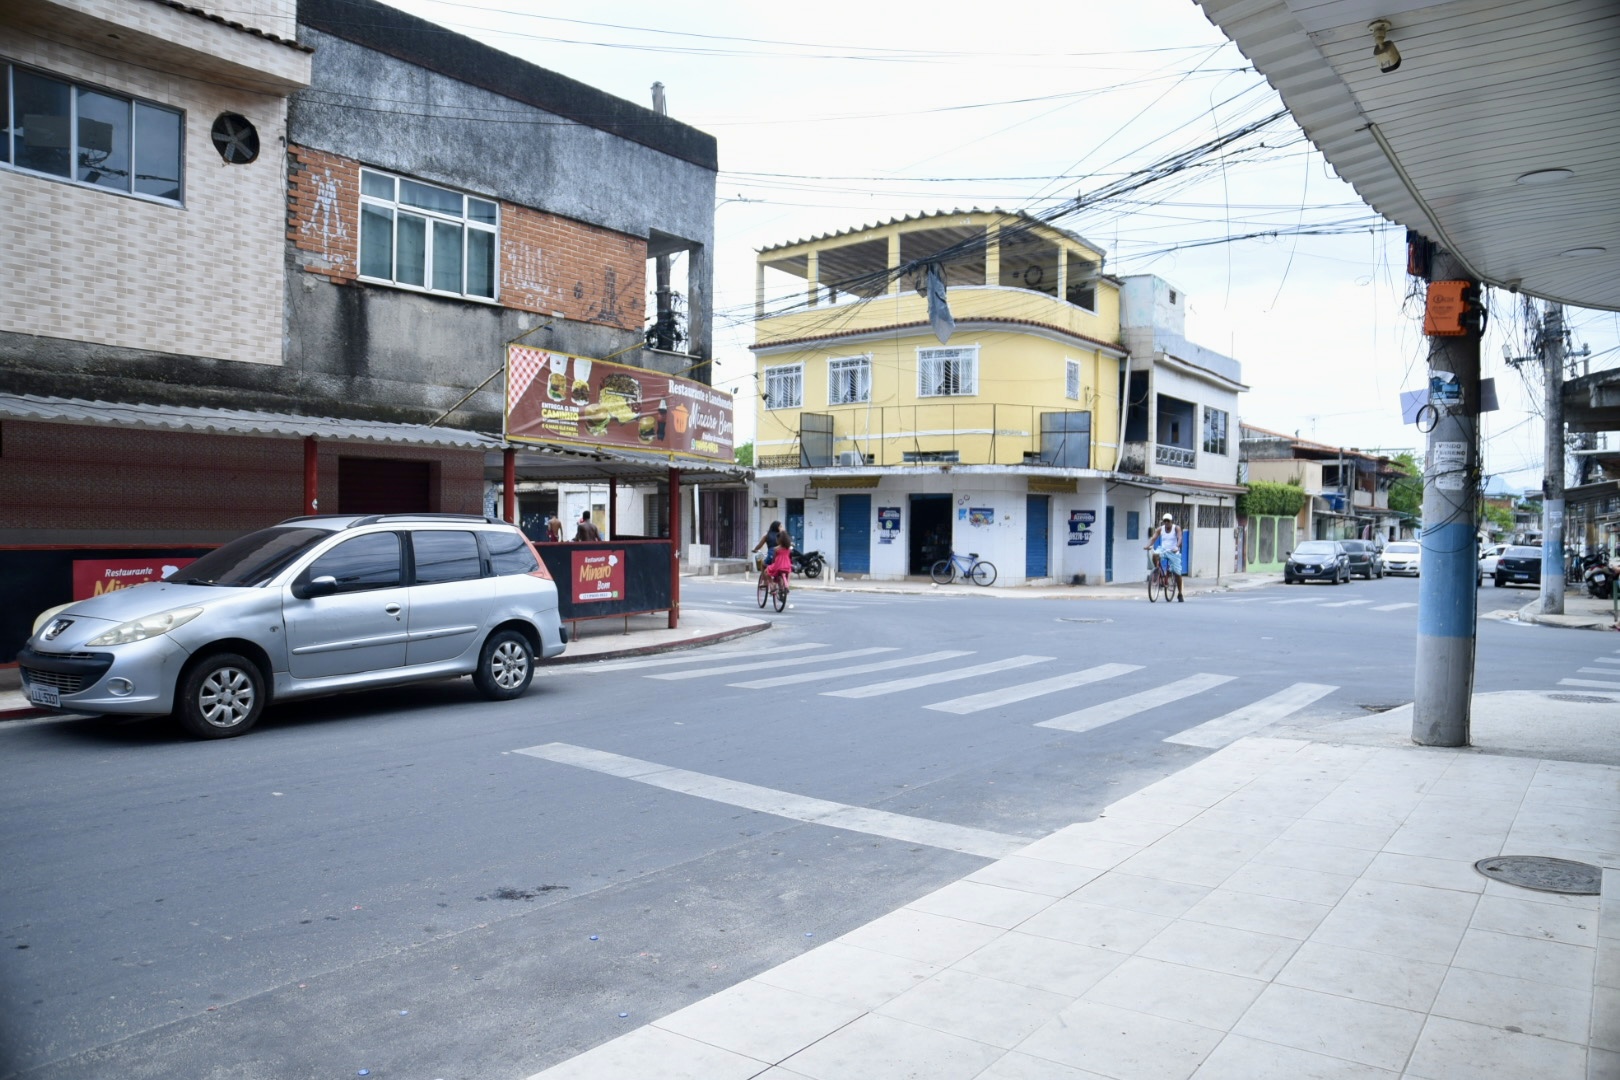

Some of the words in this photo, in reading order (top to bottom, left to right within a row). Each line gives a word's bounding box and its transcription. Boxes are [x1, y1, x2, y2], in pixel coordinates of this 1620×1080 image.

[668, 379, 704, 401] Restaurante
[541, 402, 563, 411] ENTREGA
[541, 408, 579, 421] CAMINHO
[689, 401, 717, 429] Mineiro
[718, 410, 733, 435] Bom
[104, 567, 153, 577] Restaurante
[580, 564, 611, 583] Mineiro
[597, 580, 610, 591] Bom
